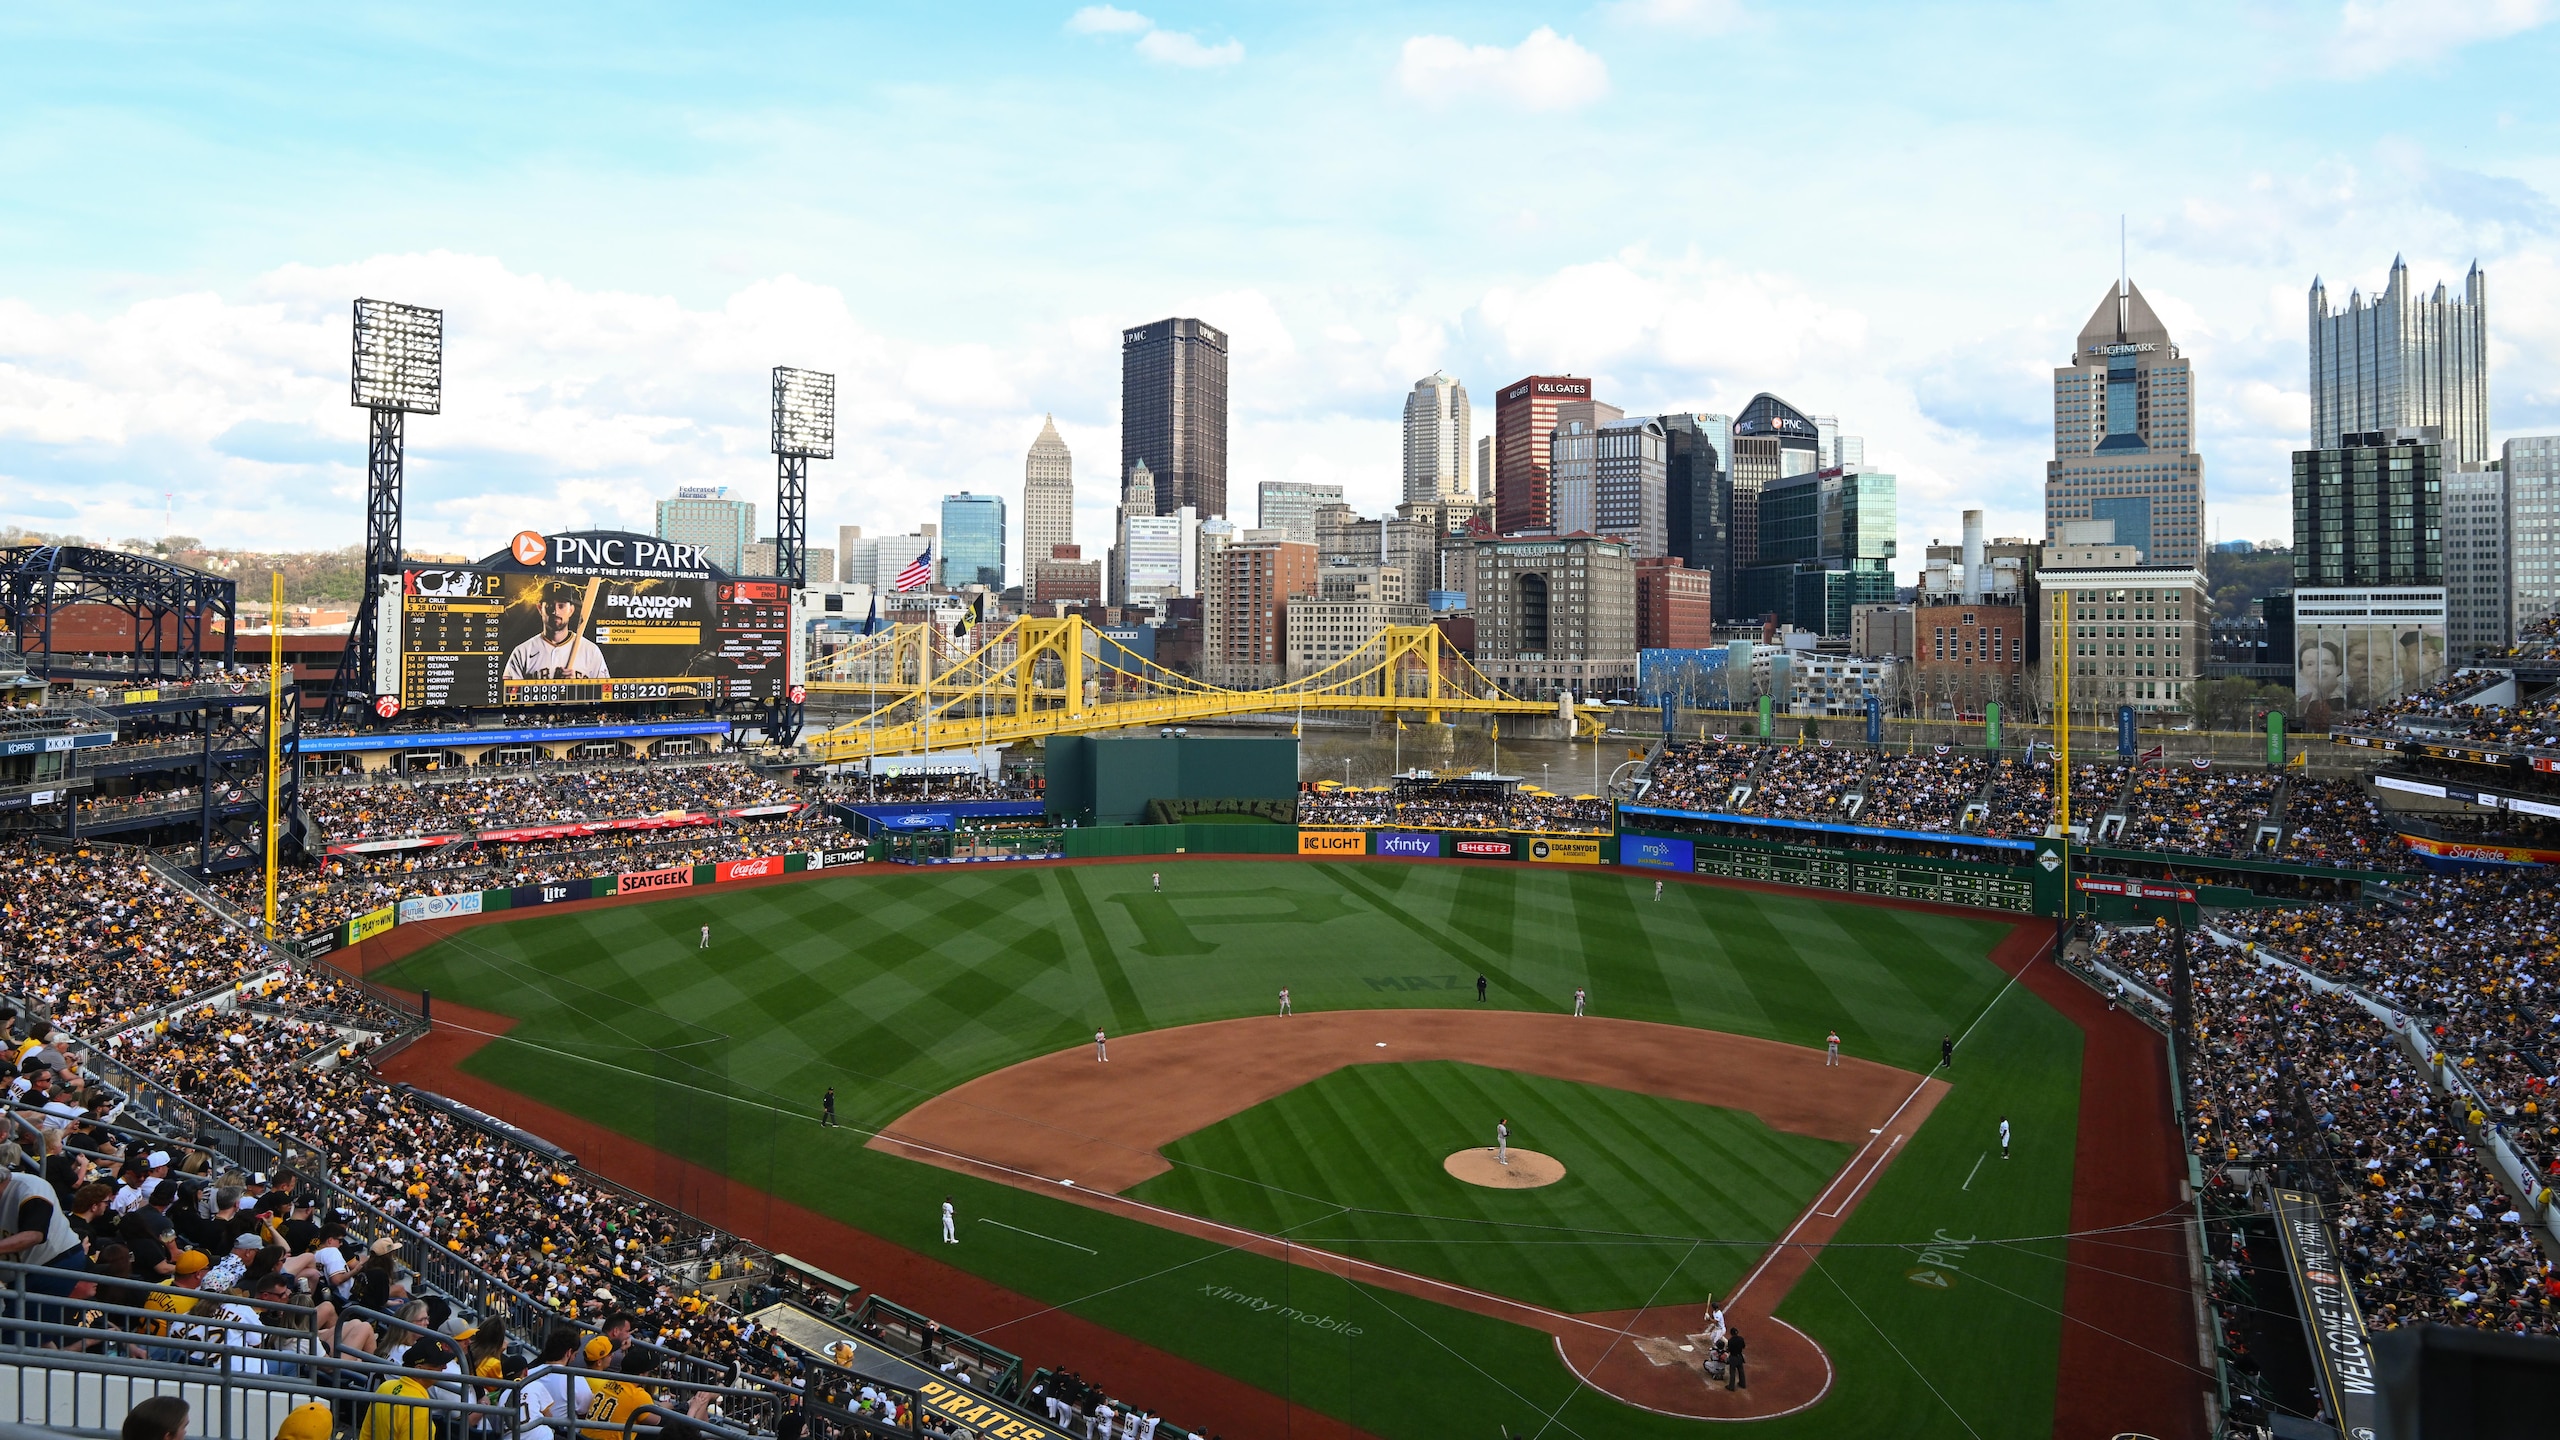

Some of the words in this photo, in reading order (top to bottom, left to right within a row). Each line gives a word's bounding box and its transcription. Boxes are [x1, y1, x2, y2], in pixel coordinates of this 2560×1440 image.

[1124, 330, 1146, 344] UPMC
[1200, 326, 1216, 342] UPMC
[2095, 343, 2156, 355] HIGHMARK
[1517, 385, 1528, 396] GATES
[1538, 384, 1555, 392] K&L
[1556, 384, 1585, 393] GATES
[1742, 420, 1753, 431] PNC
[1783, 419, 1802, 429] PNC
[553, 536, 624, 566] PNC
[632, 541, 711, 570] PARK
[556, 566, 583, 574] HOME
[586, 567, 598, 575] OF
[600, 568, 618, 576] THE
[620, 569, 673, 578] PITTSBURGH
[675, 571, 709, 579] PIRATES
[608, 595, 692, 608] BRANDON
[626, 607, 673, 618] LOWE
[386, 638, 392, 654] GO
[668, 686, 697, 696] PIRATES
[8, 742, 35, 754] KOPPERS
[902, 766, 922, 776] FAT
[926, 765, 971, 775] HEAD'S
[1431, 766, 1477, 784] Miller
[1471, 772, 1492, 780] TIME
[1169, 798, 1296, 824] PIRATES
[1305, 838, 1318, 849] IC
[1322, 838, 1360, 849] LIGHT
[1385, 837, 1430, 853] xfinity
[1461, 843, 1507, 852] SHEETZ
[1642, 844, 1658, 856] nrg
[1713, 843, 1772, 853] NATIONAL
[1782, 851, 1828, 859] LEAGUE
[824, 851, 864, 864] BETMGM
[2449, 845, 2504, 860] Surfside
[730, 860, 770, 878] Coca-Cola
[1874, 861, 1943, 872] AMERICAN
[1956, 870, 2010, 879] LEAGUE
[622, 870, 688, 892] SEATGEEK
[2082, 882, 2122, 892] SHEETZ
[460, 894, 479, 909] 125
[543, 887, 567, 902] Lite
[362, 920, 374, 933] PLAY
[380, 913, 392, 928] WIN!
[1362, 975, 1473, 992] MAZ
[2293, 1220, 2326, 1248] PARK
[1917, 1229, 1976, 1270] PNC
[2301, 1247, 2334, 1272] PNC
[2312, 1286, 2348, 1306] TO
[1197, 1284, 1278, 1312] xfinity
[1277, 1307, 1363, 1337] mobile
[2319, 1308, 2376, 1395] WELCOME
[586, 1391, 618, 1422] 30
[919, 1382, 1046, 1440] PIRATES
